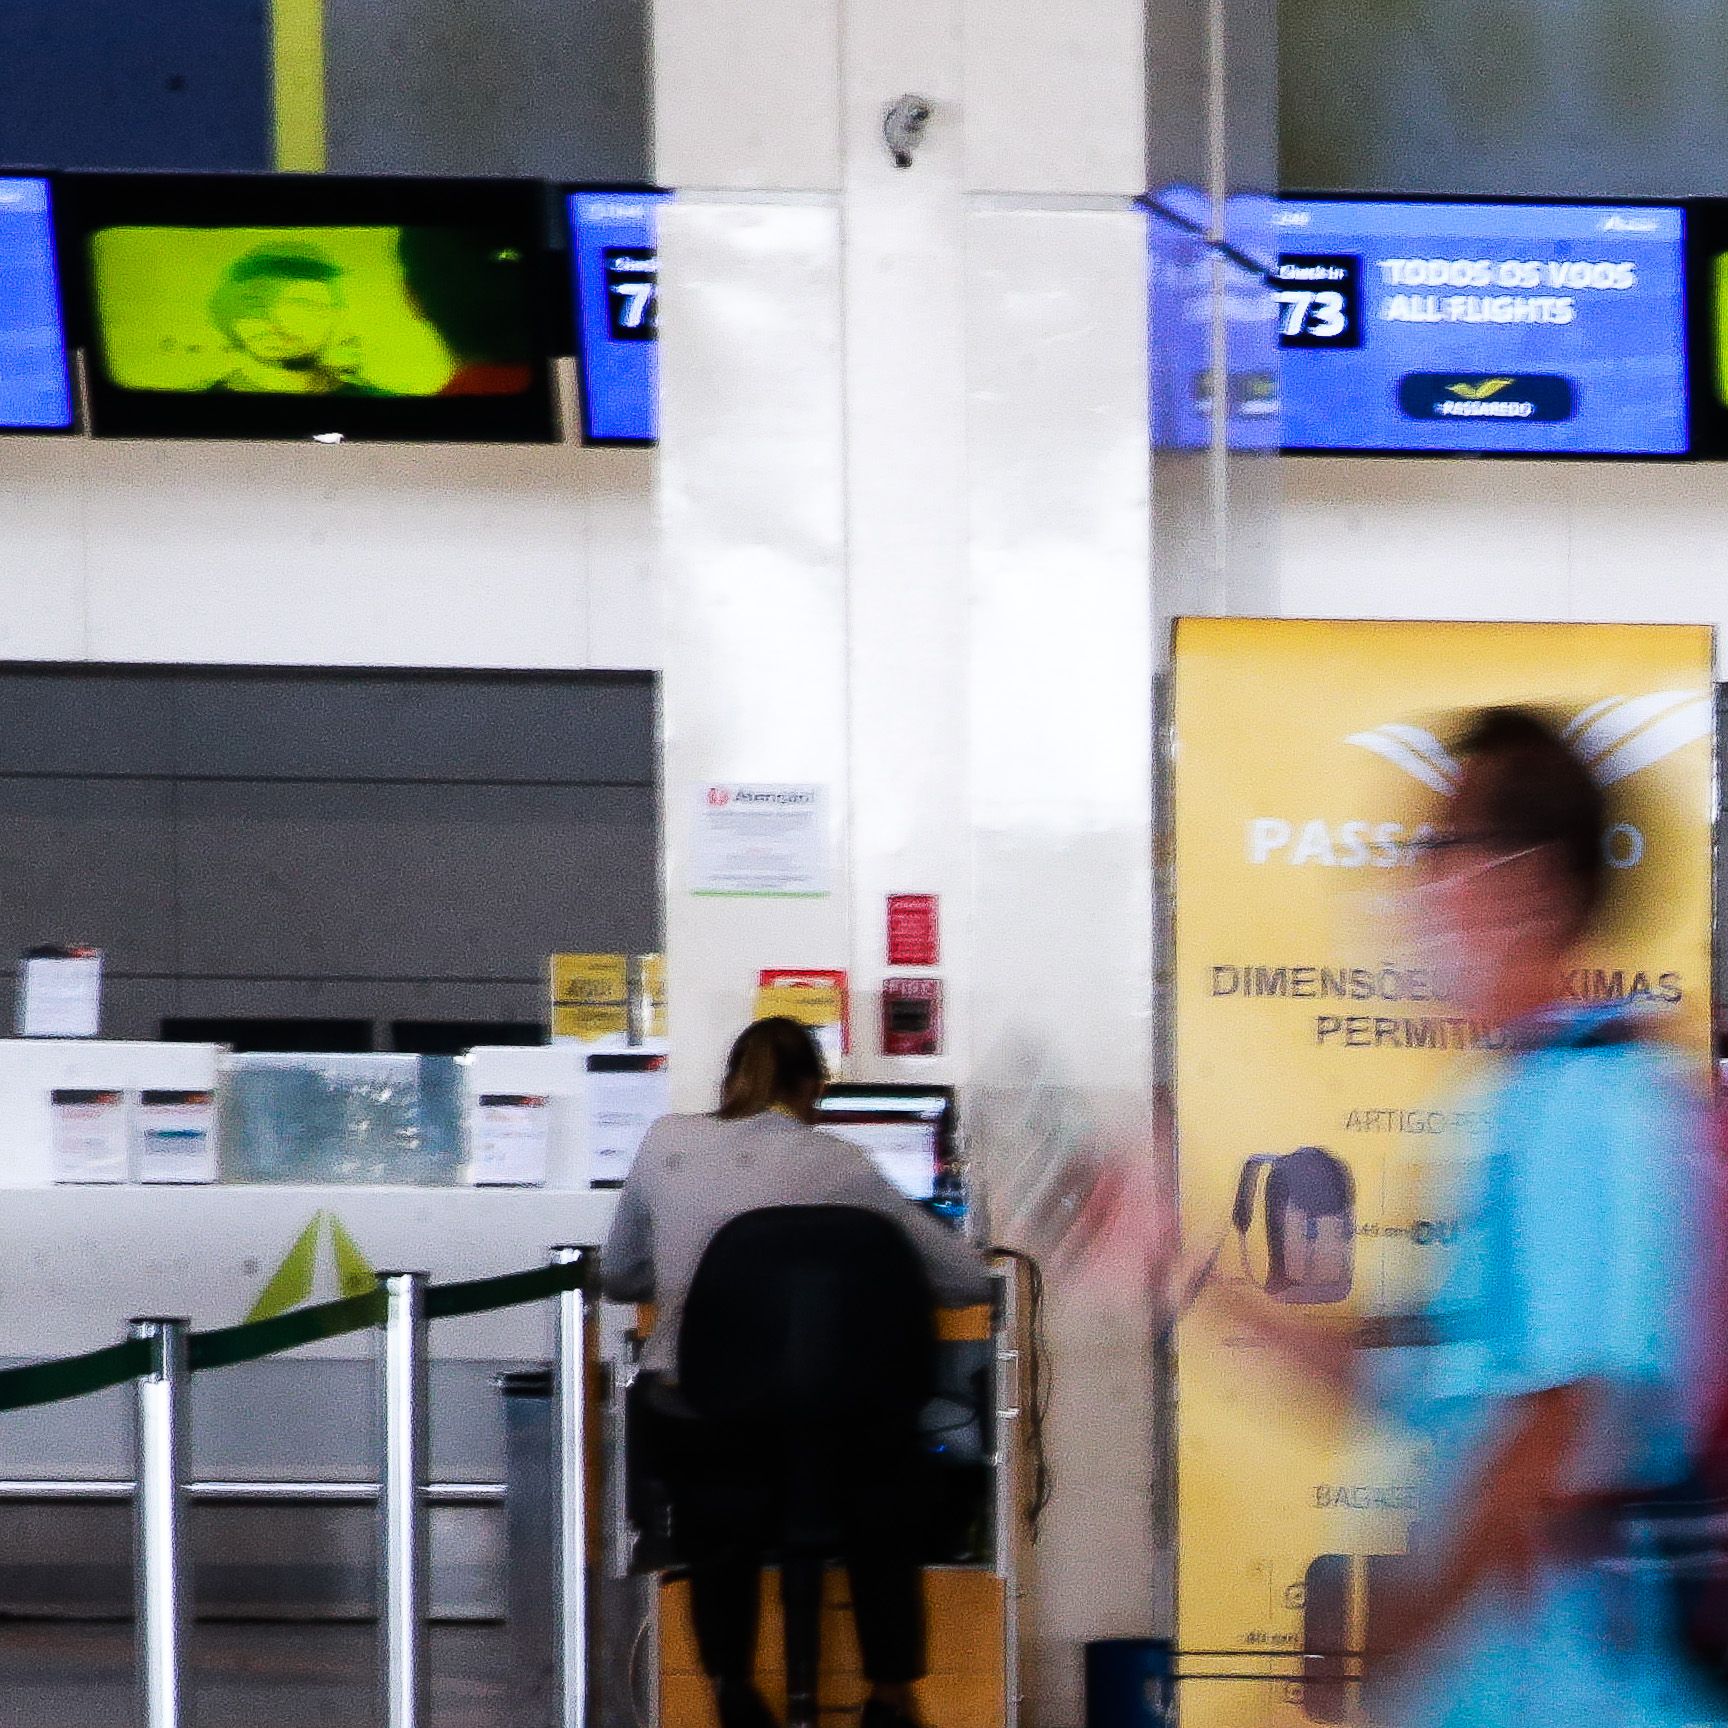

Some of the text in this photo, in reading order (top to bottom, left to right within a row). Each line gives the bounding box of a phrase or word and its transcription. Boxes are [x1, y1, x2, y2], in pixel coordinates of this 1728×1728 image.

[1380, 258, 1637, 290] TODOS OS VOOS
[1276, 291, 1346, 337] 73
[1386, 293, 1576, 324] ALL FLIGHTS
